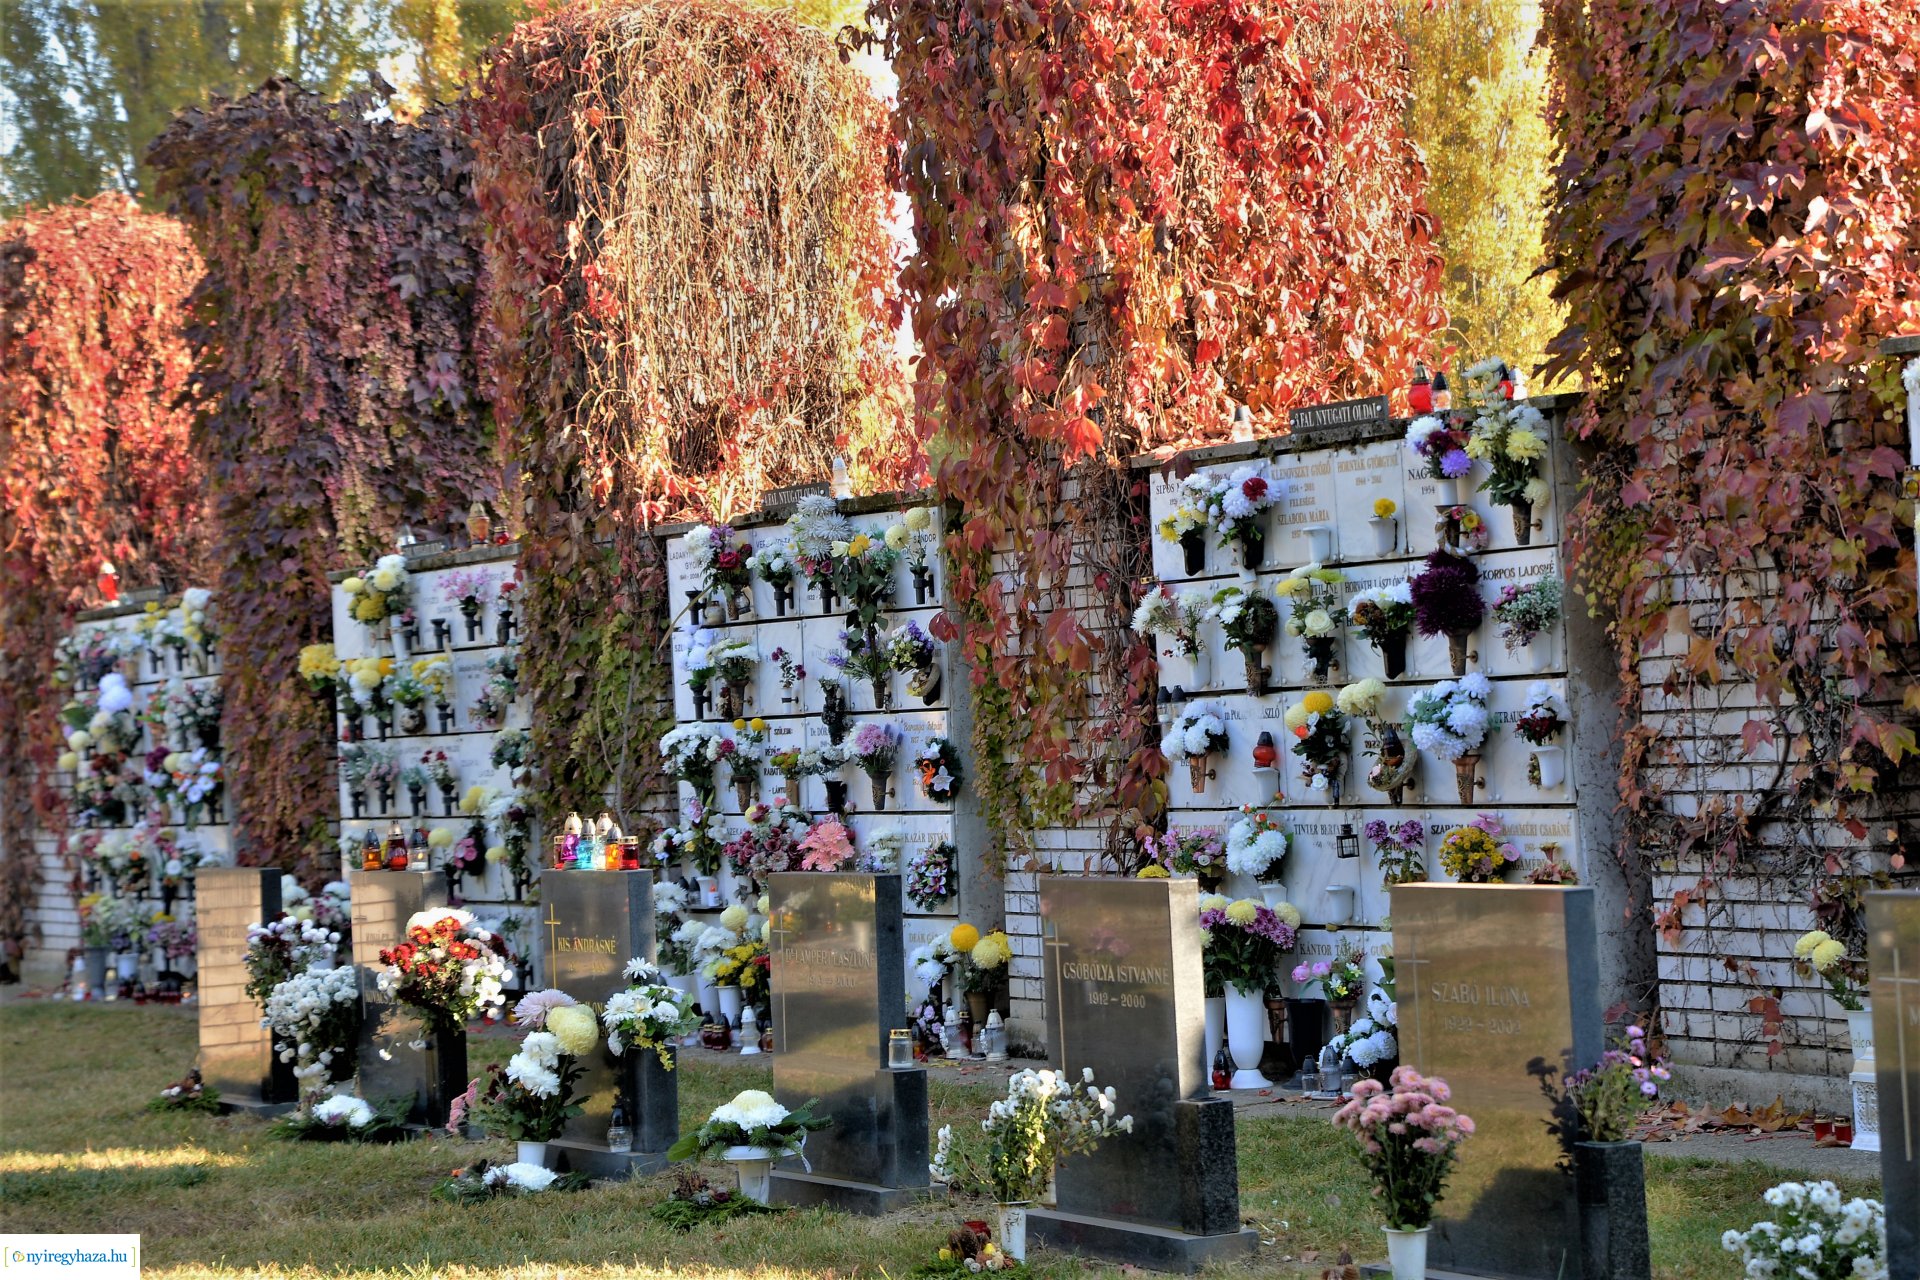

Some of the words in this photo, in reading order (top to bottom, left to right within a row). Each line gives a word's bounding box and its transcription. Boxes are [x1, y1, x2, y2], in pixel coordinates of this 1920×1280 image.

[1316, 406, 1351, 426] NYUGATI
[1352, 402, 1378, 421] OLDAL
[1482, 566, 1516, 581] KORPOS
[1300, 939, 1332, 956] KÁNTOR
[1062, 962, 1115, 982] CSOBOLYA
[1120, 993, 1146, 1009] 2000
[1431, 980, 1481, 1005] SZABÓ
[1485, 985, 1531, 1009] ILONA
